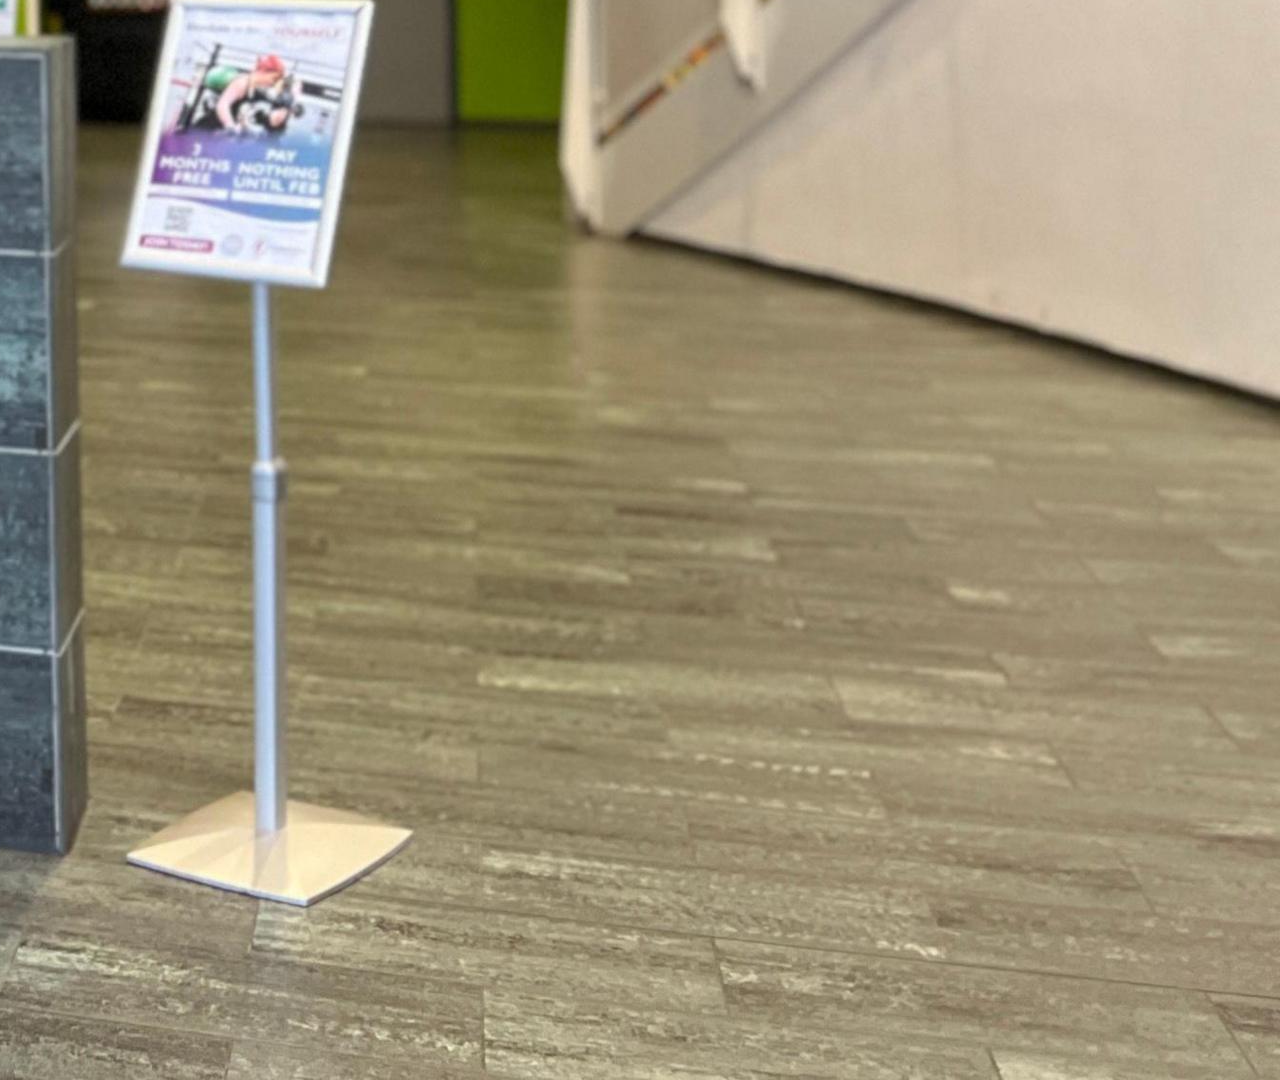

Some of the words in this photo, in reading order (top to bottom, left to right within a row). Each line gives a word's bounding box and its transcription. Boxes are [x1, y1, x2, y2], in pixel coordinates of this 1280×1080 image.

[159, 155, 231, 172] MONTHS
[266, 148, 298, 163] PAY
[172, 171, 212, 186] FREE
[238, 162, 320, 181] NOTHING
[232, 176, 285, 192] UNTIL
[289, 180, 320, 196] FEB
